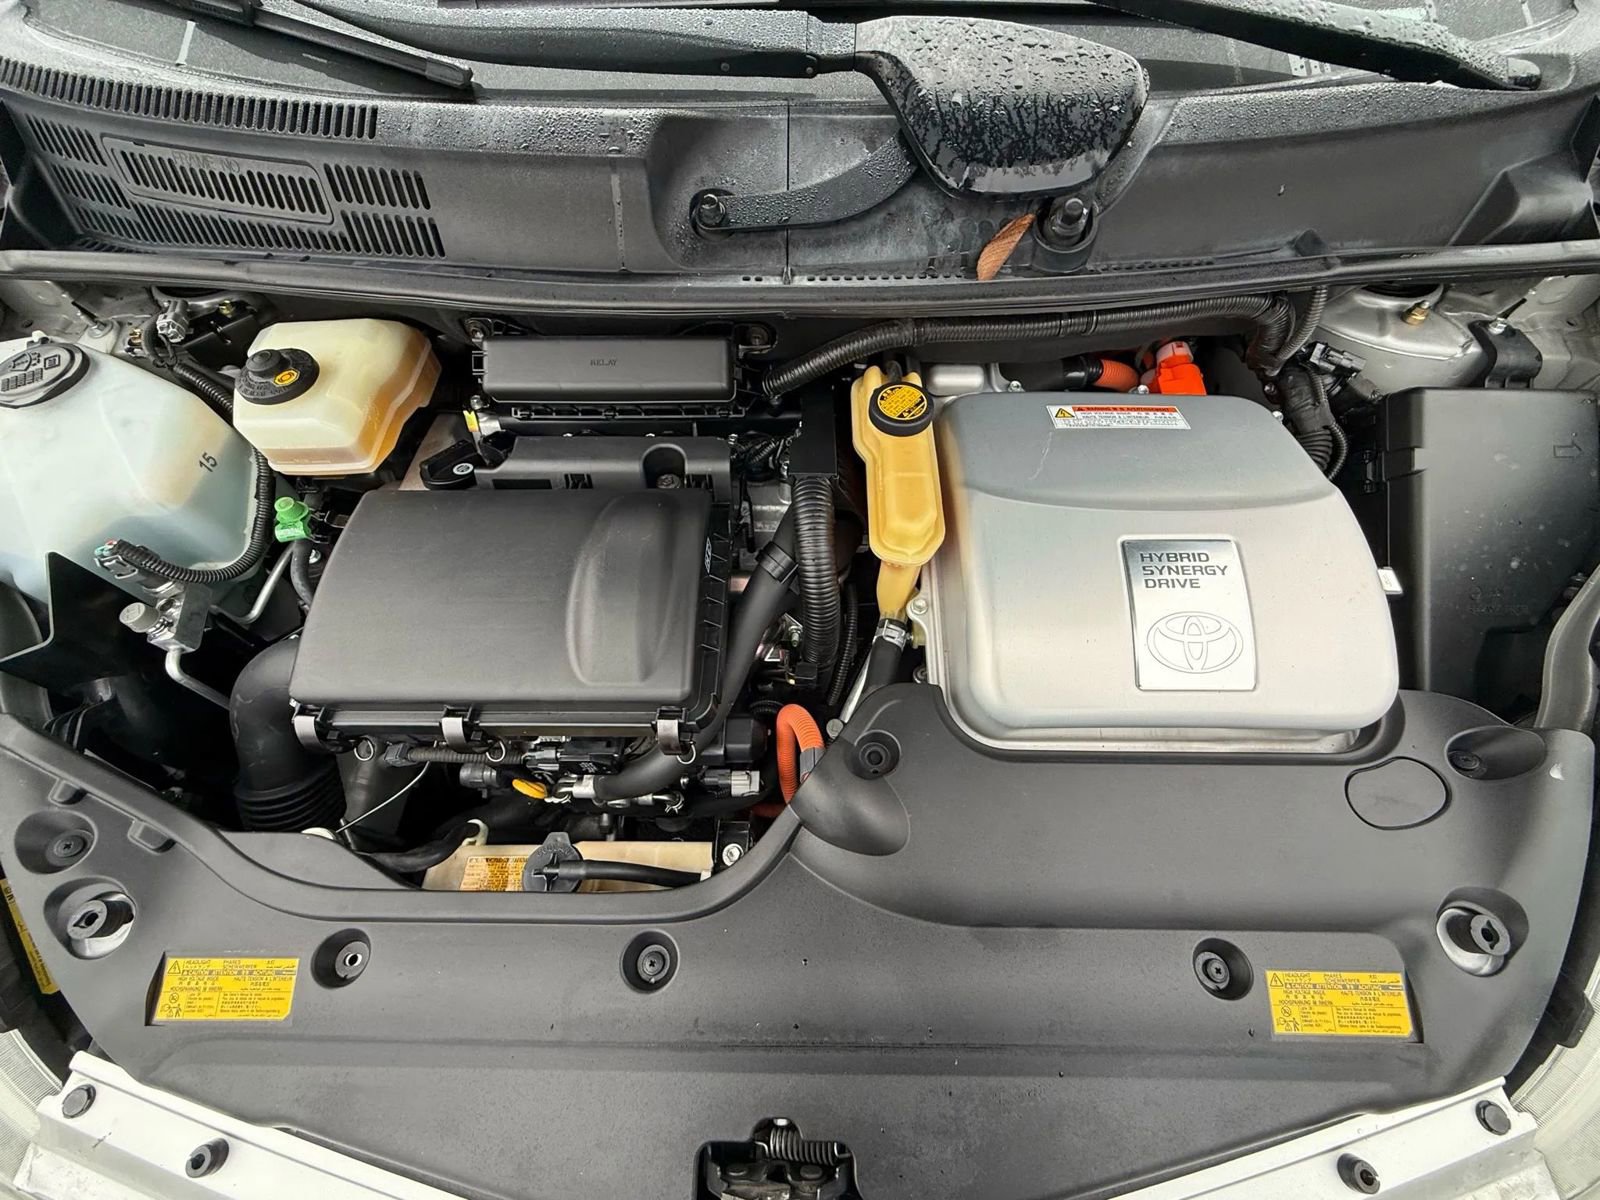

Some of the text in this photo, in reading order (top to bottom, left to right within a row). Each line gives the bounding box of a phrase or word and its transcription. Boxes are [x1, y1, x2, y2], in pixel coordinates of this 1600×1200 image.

[590, 359, 617, 367] RELAY
[199, 451, 218, 473] 15
[1140, 552, 1210, 562] HYBRID
[1142, 565, 1228, 576] SYNERGY
[1144, 578, 1201, 589] DRIVE
